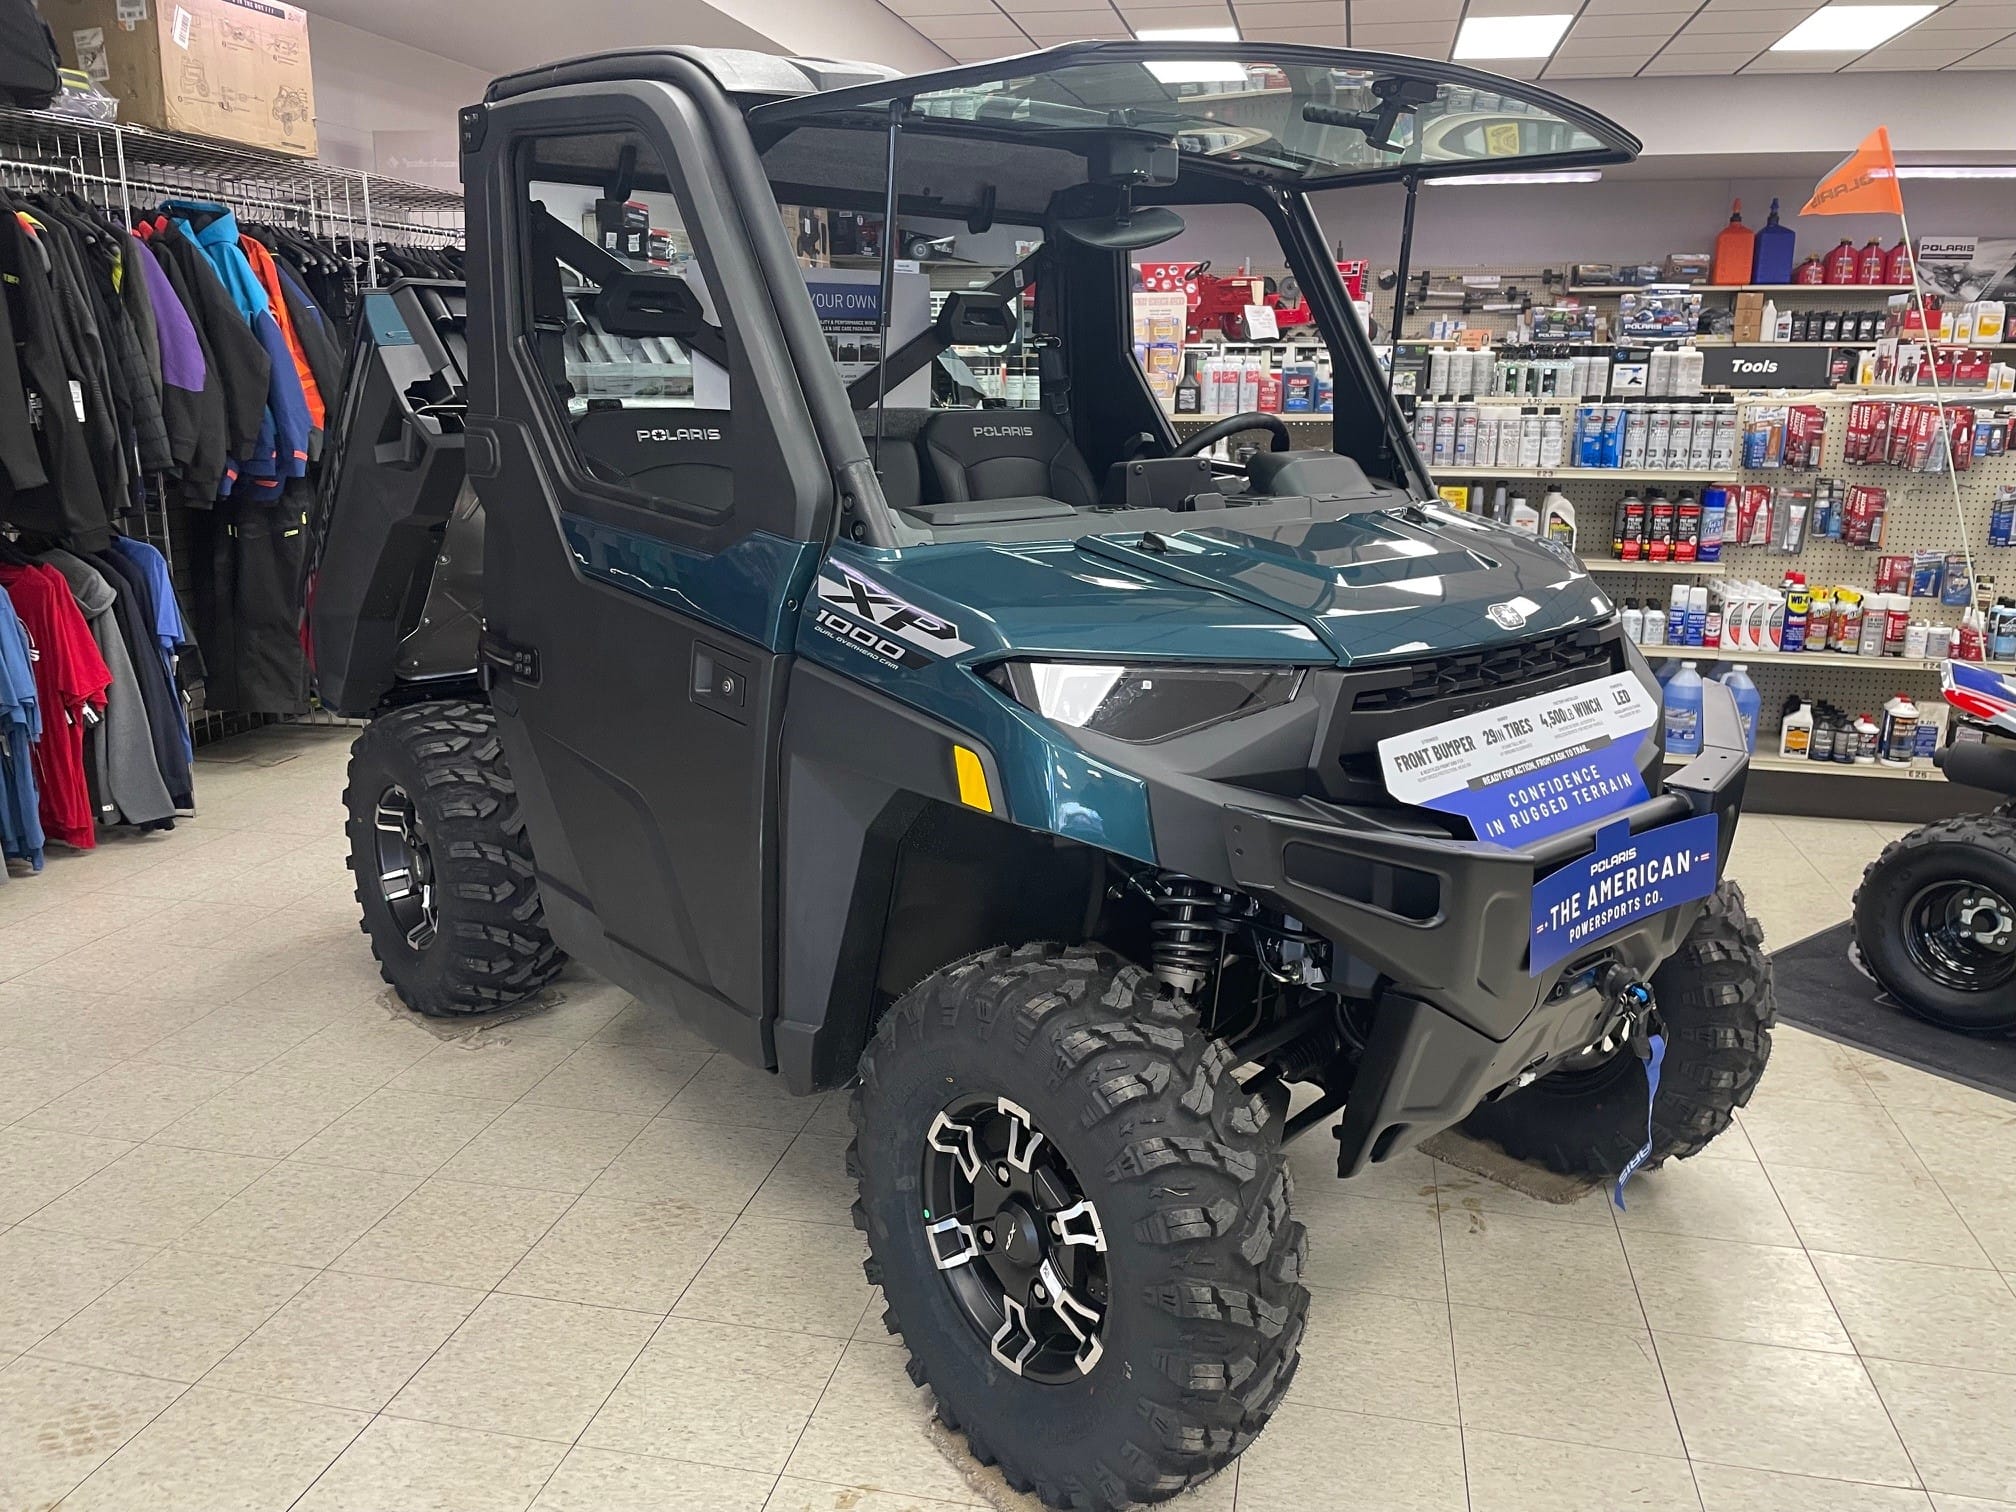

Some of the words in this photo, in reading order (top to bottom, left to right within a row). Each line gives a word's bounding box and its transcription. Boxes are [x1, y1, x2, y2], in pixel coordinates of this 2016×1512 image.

[1921, 244, 1975, 252] POLARIS
[846, 294, 877, 309] OWN
[1732, 359, 1778, 373] Tools
[1850, 404, 1859, 428] LOCTITE
[1862, 406, 1871, 430] LOCTITE
[1901, 406, 1912, 430] LOCTITE
[1919, 411, 1930, 436] LOCTITE
[636, 428, 721, 442] POLARIS
[972, 426, 1033, 437] POLARIS
[820, 574, 959, 640] XP
[815, 609, 906, 660] 1000
[814, 625, 835, 639] DUAL
[836, 636, 880, 661] OVERHEAD
[879, 657, 899, 670] CAM
[1572, 697, 1603, 718] WINCH
[1612, 689, 1631, 706] LED
[1503, 718, 1534, 739] TIRES
[1394, 748, 1432, 772] FRONT
[1431, 735, 1477, 761] BUMPER
[1482, 774, 1502, 786] READY
[1502, 769, 1515, 780] FOR
[1536, 757, 1552, 769] FROM
[1550, 753, 1566, 763] TASK
[1565, 749, 1574, 758] TO
[1508, 764, 1601, 807] CONFIDENCE
[1486, 819, 1505, 837] IN
[1509, 796, 1568, 829] RUGGED
[1572, 772, 1633, 805] TERRAIN
[1590, 847, 1637, 876] POLARIS
[1550, 892, 1581, 931] THE
[1587, 850, 1690, 911] AMERICAN
[1569, 896, 1641, 943] POWERSPORTS
[1645, 890, 1663, 907] CO.
